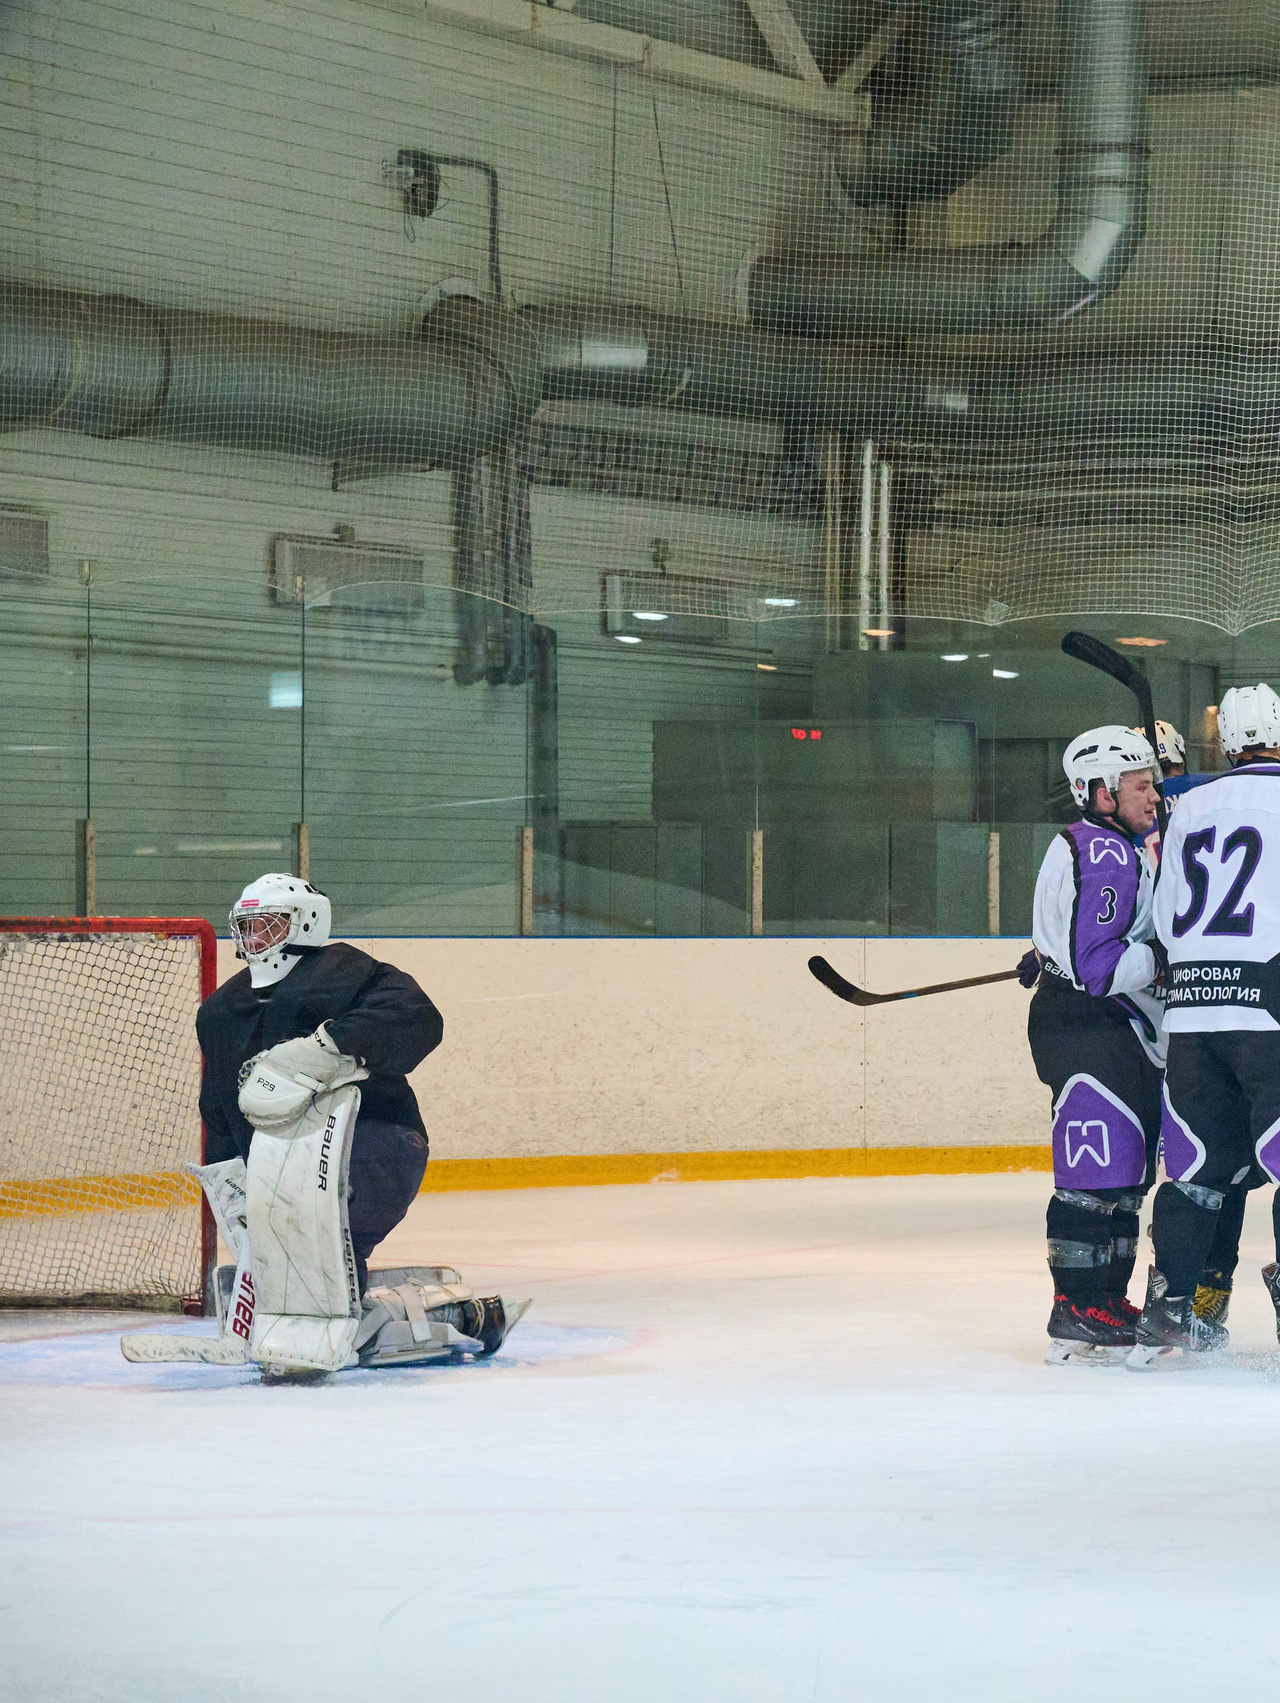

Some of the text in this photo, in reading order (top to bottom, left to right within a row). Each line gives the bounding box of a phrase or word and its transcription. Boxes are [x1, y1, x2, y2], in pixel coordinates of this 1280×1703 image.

[1172, 825, 1262, 938] 52
[1097, 885, 1118, 925] 3
[1172, 967, 1242, 985] ЦИФРОВАЯ
[256, 1077, 276, 1092] P29
[317, 1114, 337, 1192] BAUER
[224, 1178, 247, 1199] AUER
